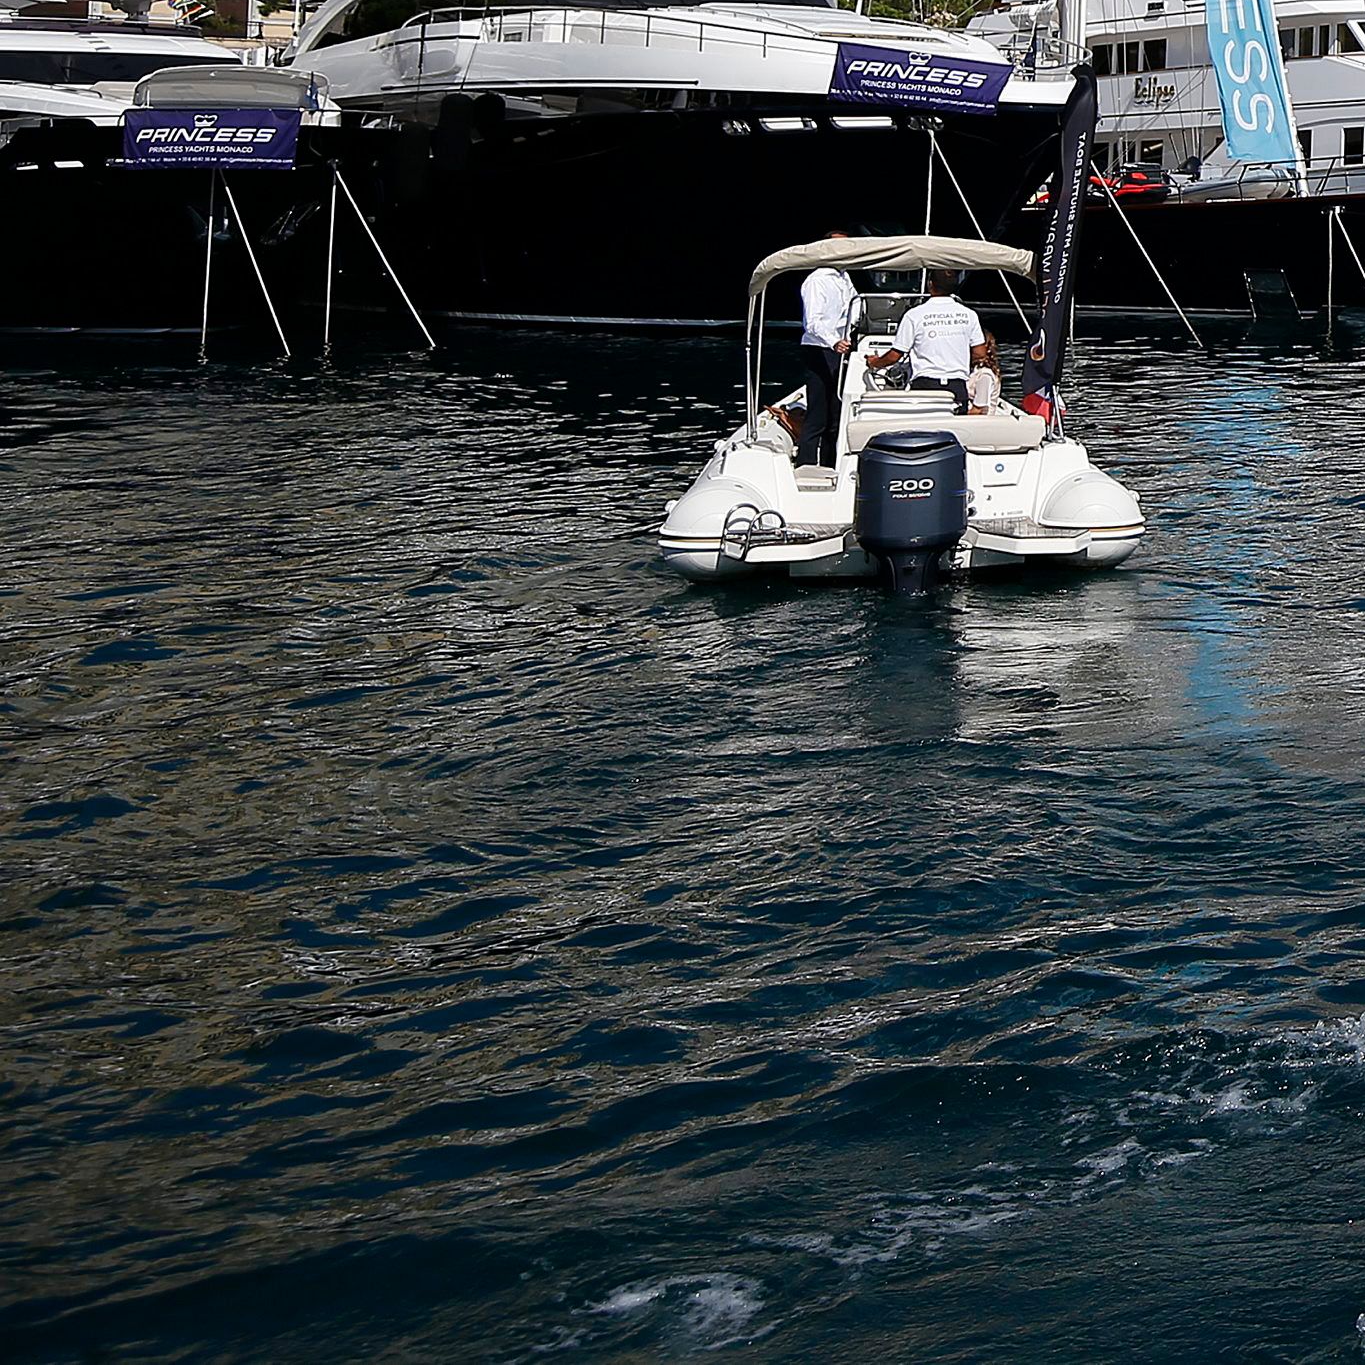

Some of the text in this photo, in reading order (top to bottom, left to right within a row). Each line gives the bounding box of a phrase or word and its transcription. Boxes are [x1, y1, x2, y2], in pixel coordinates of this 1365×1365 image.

[846, 60, 988, 88] PRINCESS
[860, 79, 962, 96] PRINCESS YACHTS MONACO
[1134, 76, 1175, 110] Eclipse
[136, 128, 277, 144] PRINCESS
[149, 145, 254, 154] PRINCESS YACHTS MONACO
[889, 478, 934, 492] 200
